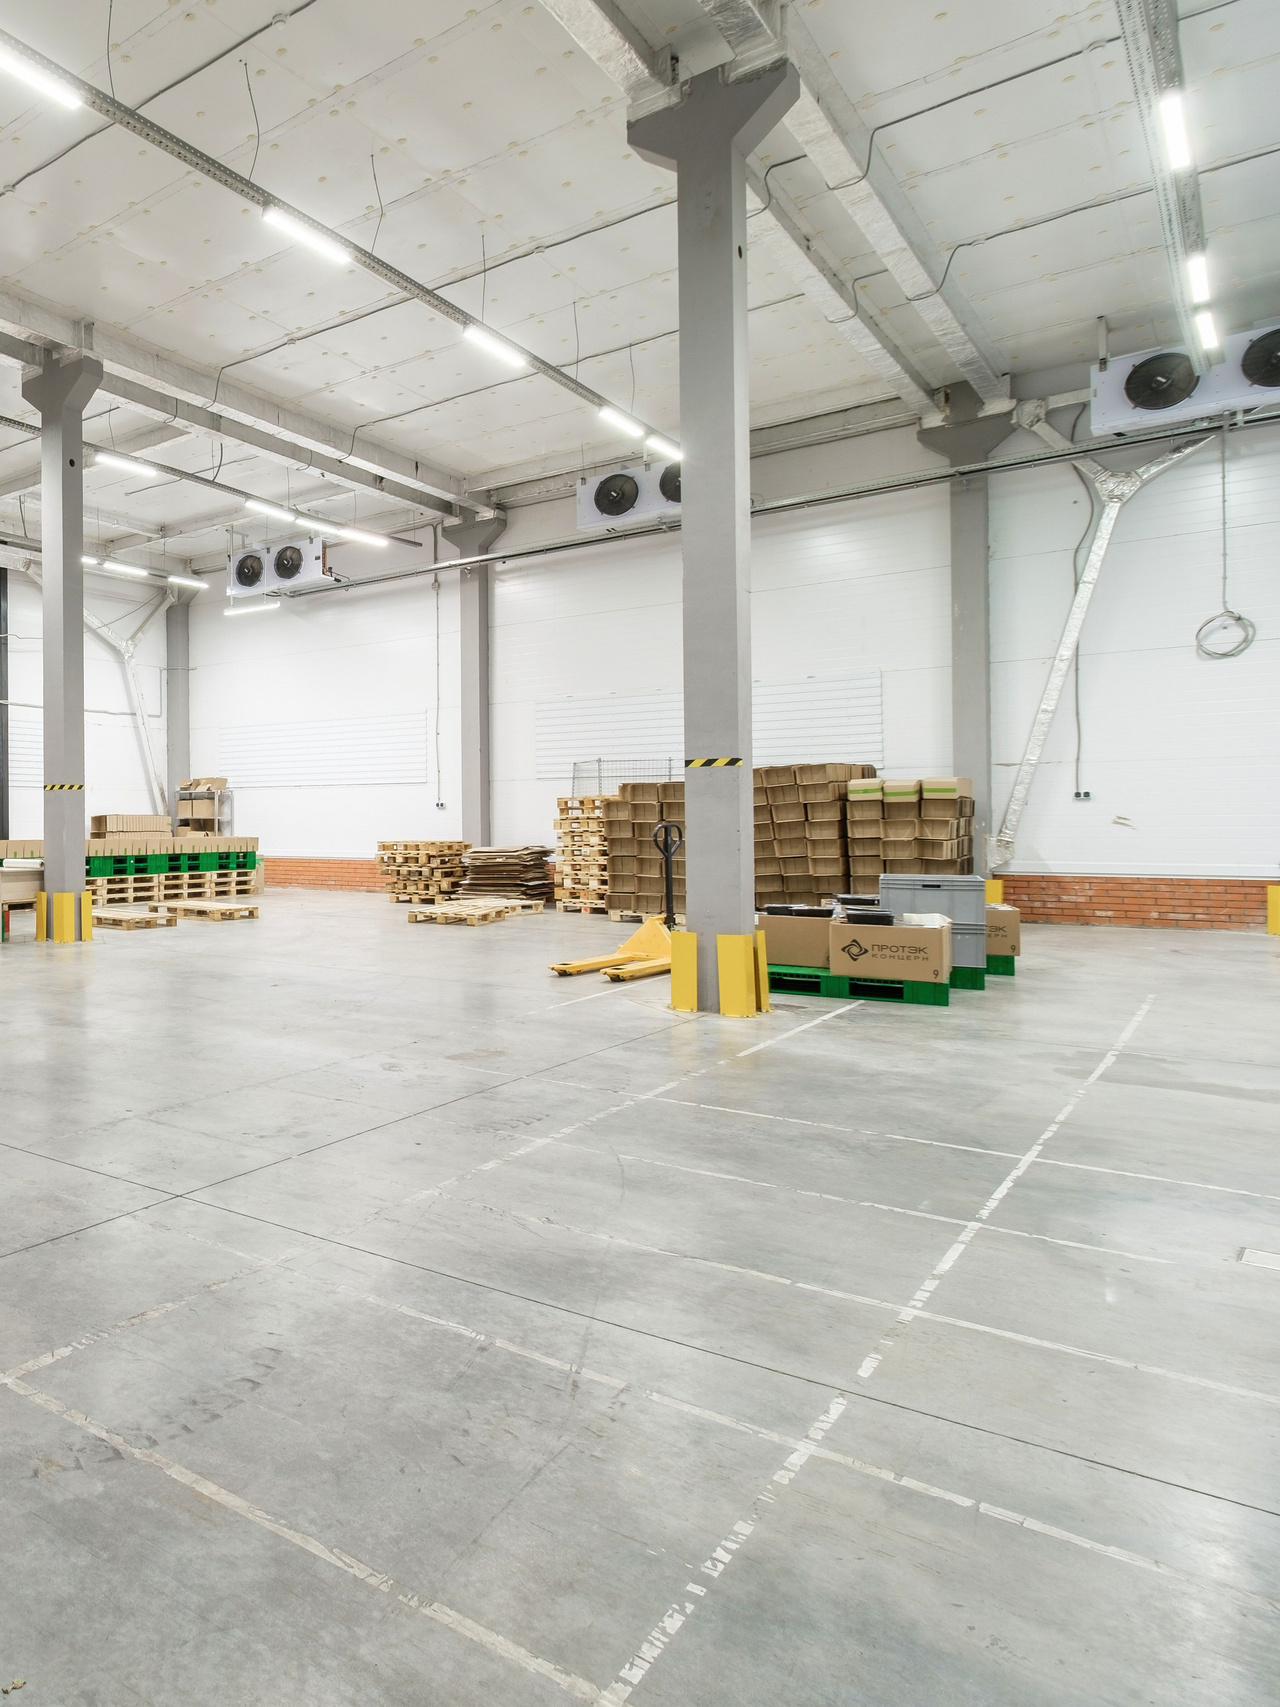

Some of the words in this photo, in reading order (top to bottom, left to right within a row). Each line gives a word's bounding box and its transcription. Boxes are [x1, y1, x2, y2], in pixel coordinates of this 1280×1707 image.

[871, 944, 928, 955] ПРОТЭК
[1010, 944, 1016, 953] 9
[871, 953, 929, 961] КОНЦЕРН
[932, 969, 939, 979] 9
